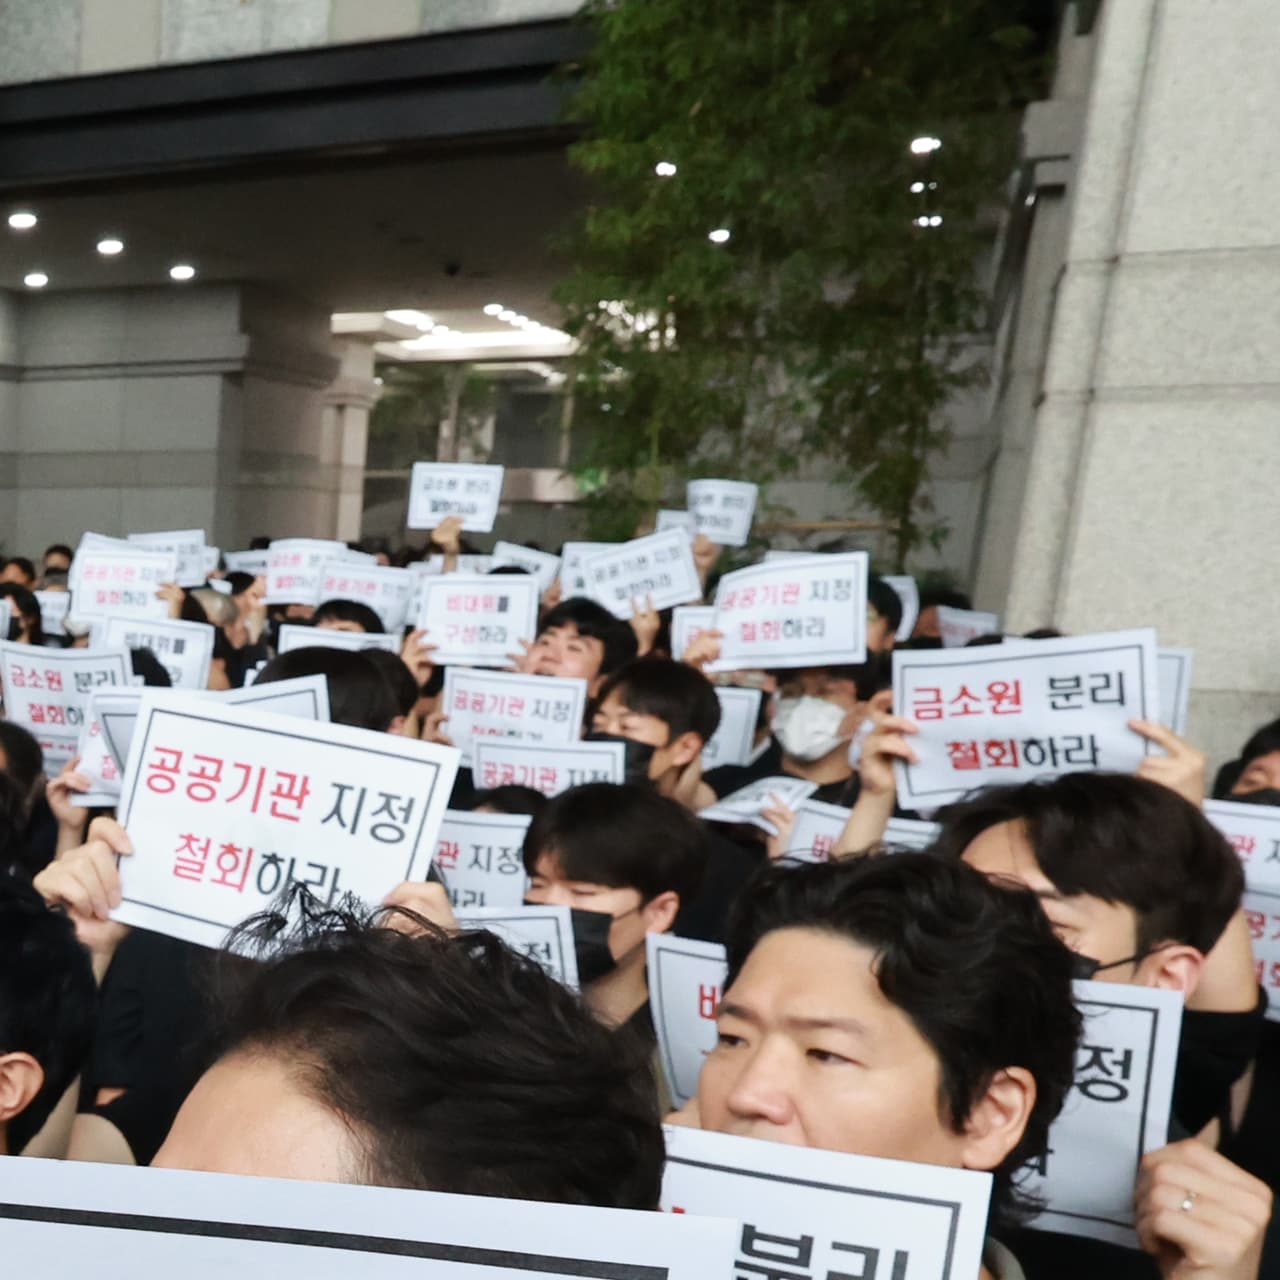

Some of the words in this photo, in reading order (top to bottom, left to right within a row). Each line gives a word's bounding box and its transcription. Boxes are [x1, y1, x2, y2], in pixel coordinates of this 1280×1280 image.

[808, 578, 852, 602] 지정
[11, 664, 63, 693] 금소원
[73, 670, 117, 693] 분리
[913, 679, 1023, 721] 금소원
[1047, 670, 1126, 711] 분리
[27, 703, 84, 726] 철회하
[453, 689, 525, 718] 공공기관
[531, 697, 571, 722] 지정
[945, 733, 1100, 771] 철회하라
[145, 744, 311, 823] 공공기관
[320, 781, 415, 845] 지정
[172, 832, 342, 909] 철회하라
[467, 843, 522, 876] 지정
[1078, 1044, 1134, 1105] 정
